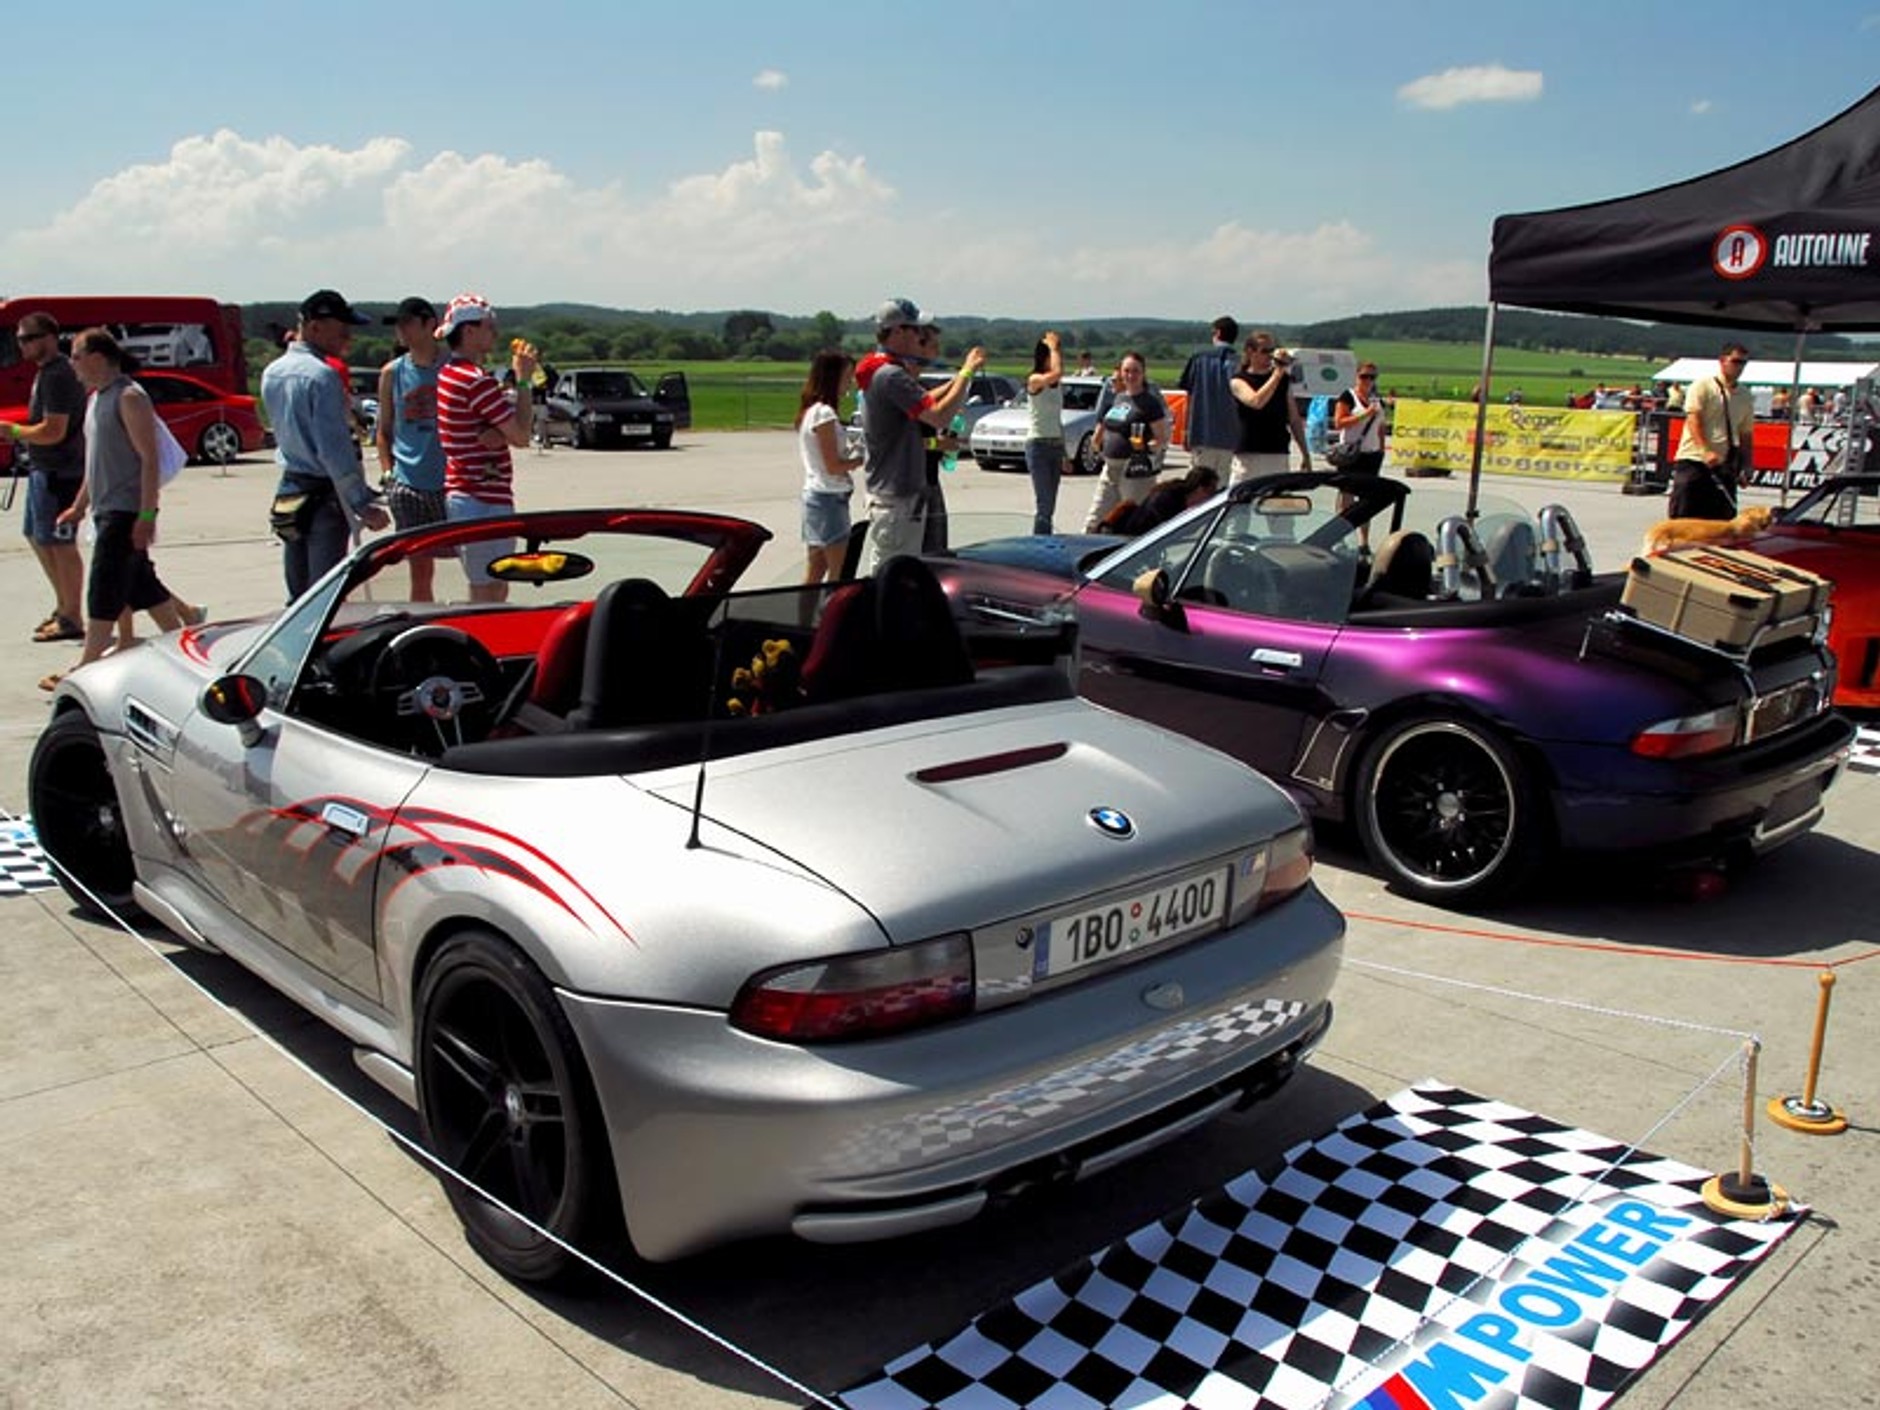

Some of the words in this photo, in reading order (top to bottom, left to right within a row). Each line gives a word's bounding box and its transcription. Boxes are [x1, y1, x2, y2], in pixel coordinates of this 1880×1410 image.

[1773, 232, 1871, 267] AUTOLINE
[1147, 878, 1215, 937] 4400
[1454, 1200, 1694, 1362] POWER
[1401, 1341, 1508, 1410] M
